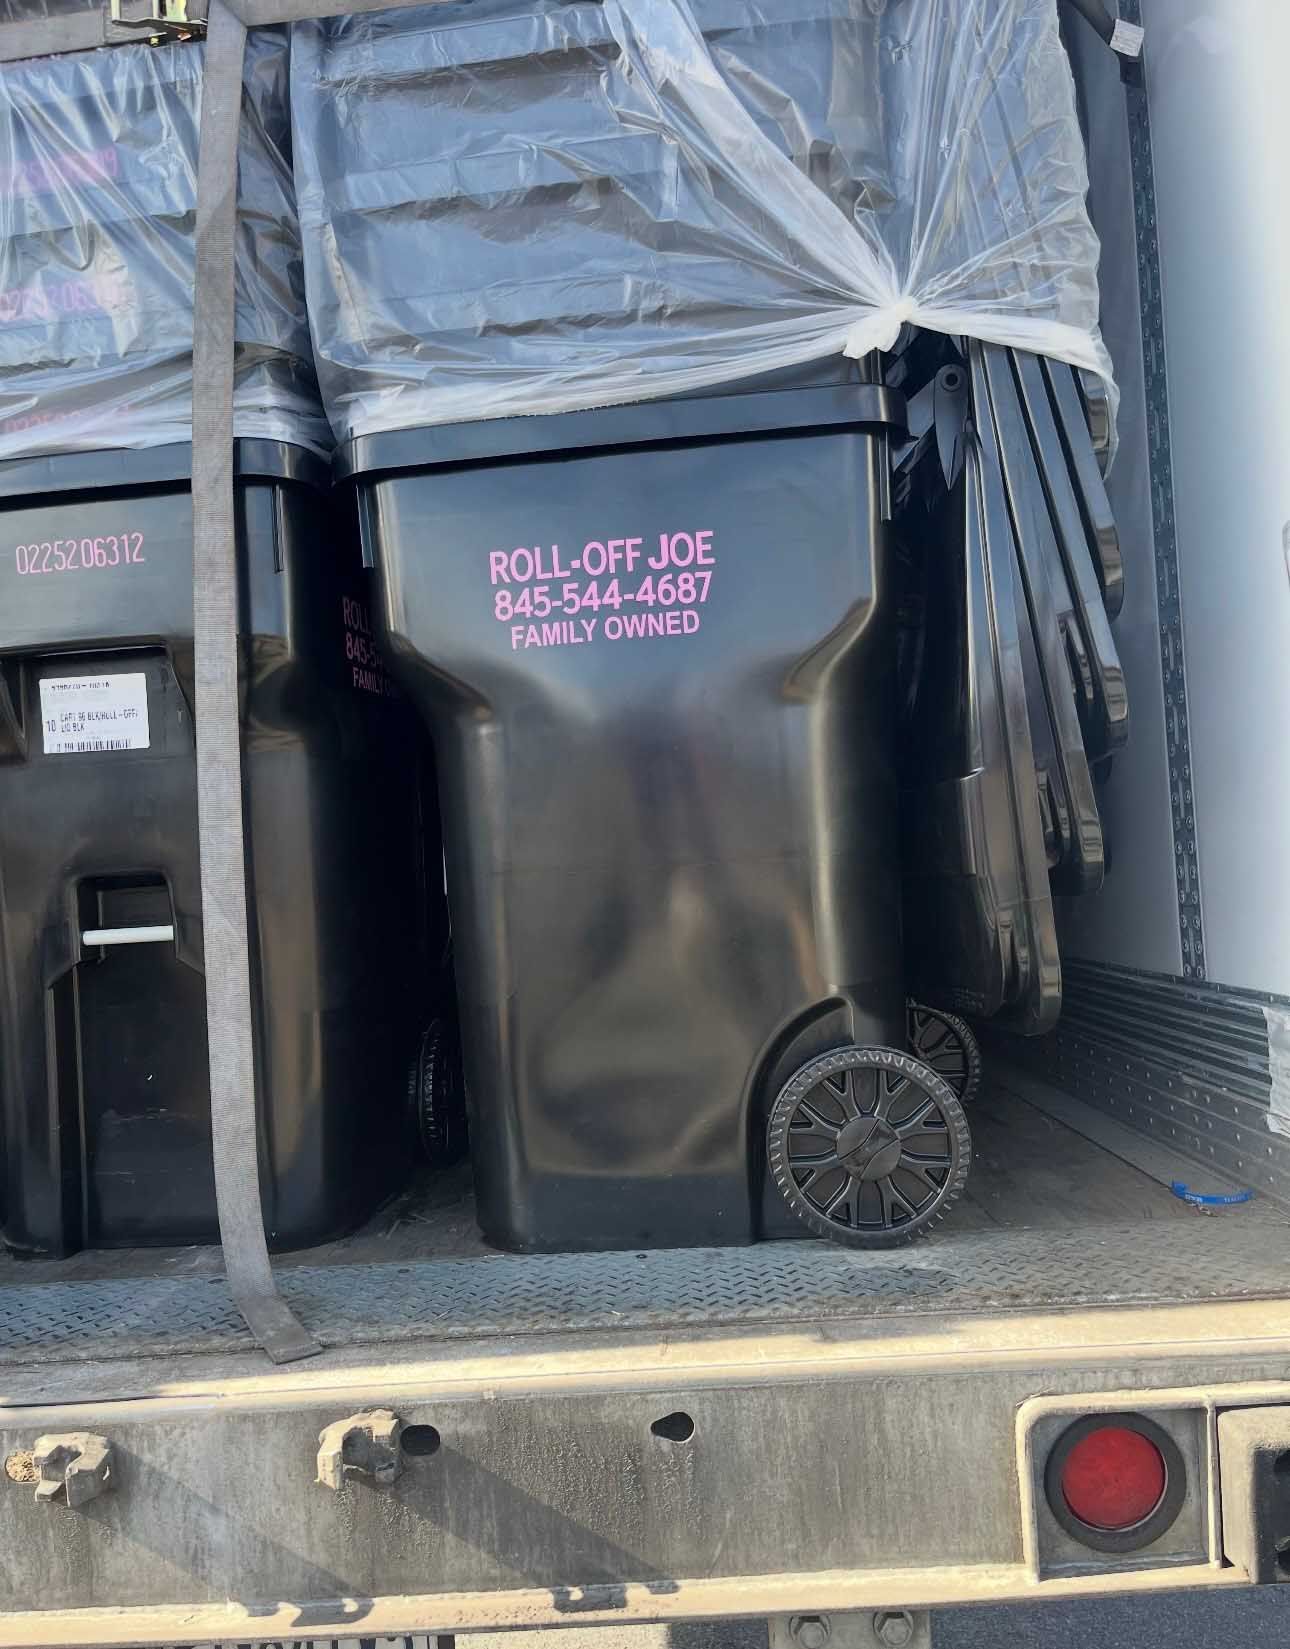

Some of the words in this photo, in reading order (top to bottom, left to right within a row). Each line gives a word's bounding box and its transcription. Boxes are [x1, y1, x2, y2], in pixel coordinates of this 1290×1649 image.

[16, 532, 145, 575] 0225206312
[490, 537, 643, 585] ROLL-OFF
[648, 530, 716, 570] JOE
[494, 571, 713, 622] 845-544-4687
[511, 618, 597, 650] FAMILY
[604, 610, 700, 640] OWNED
